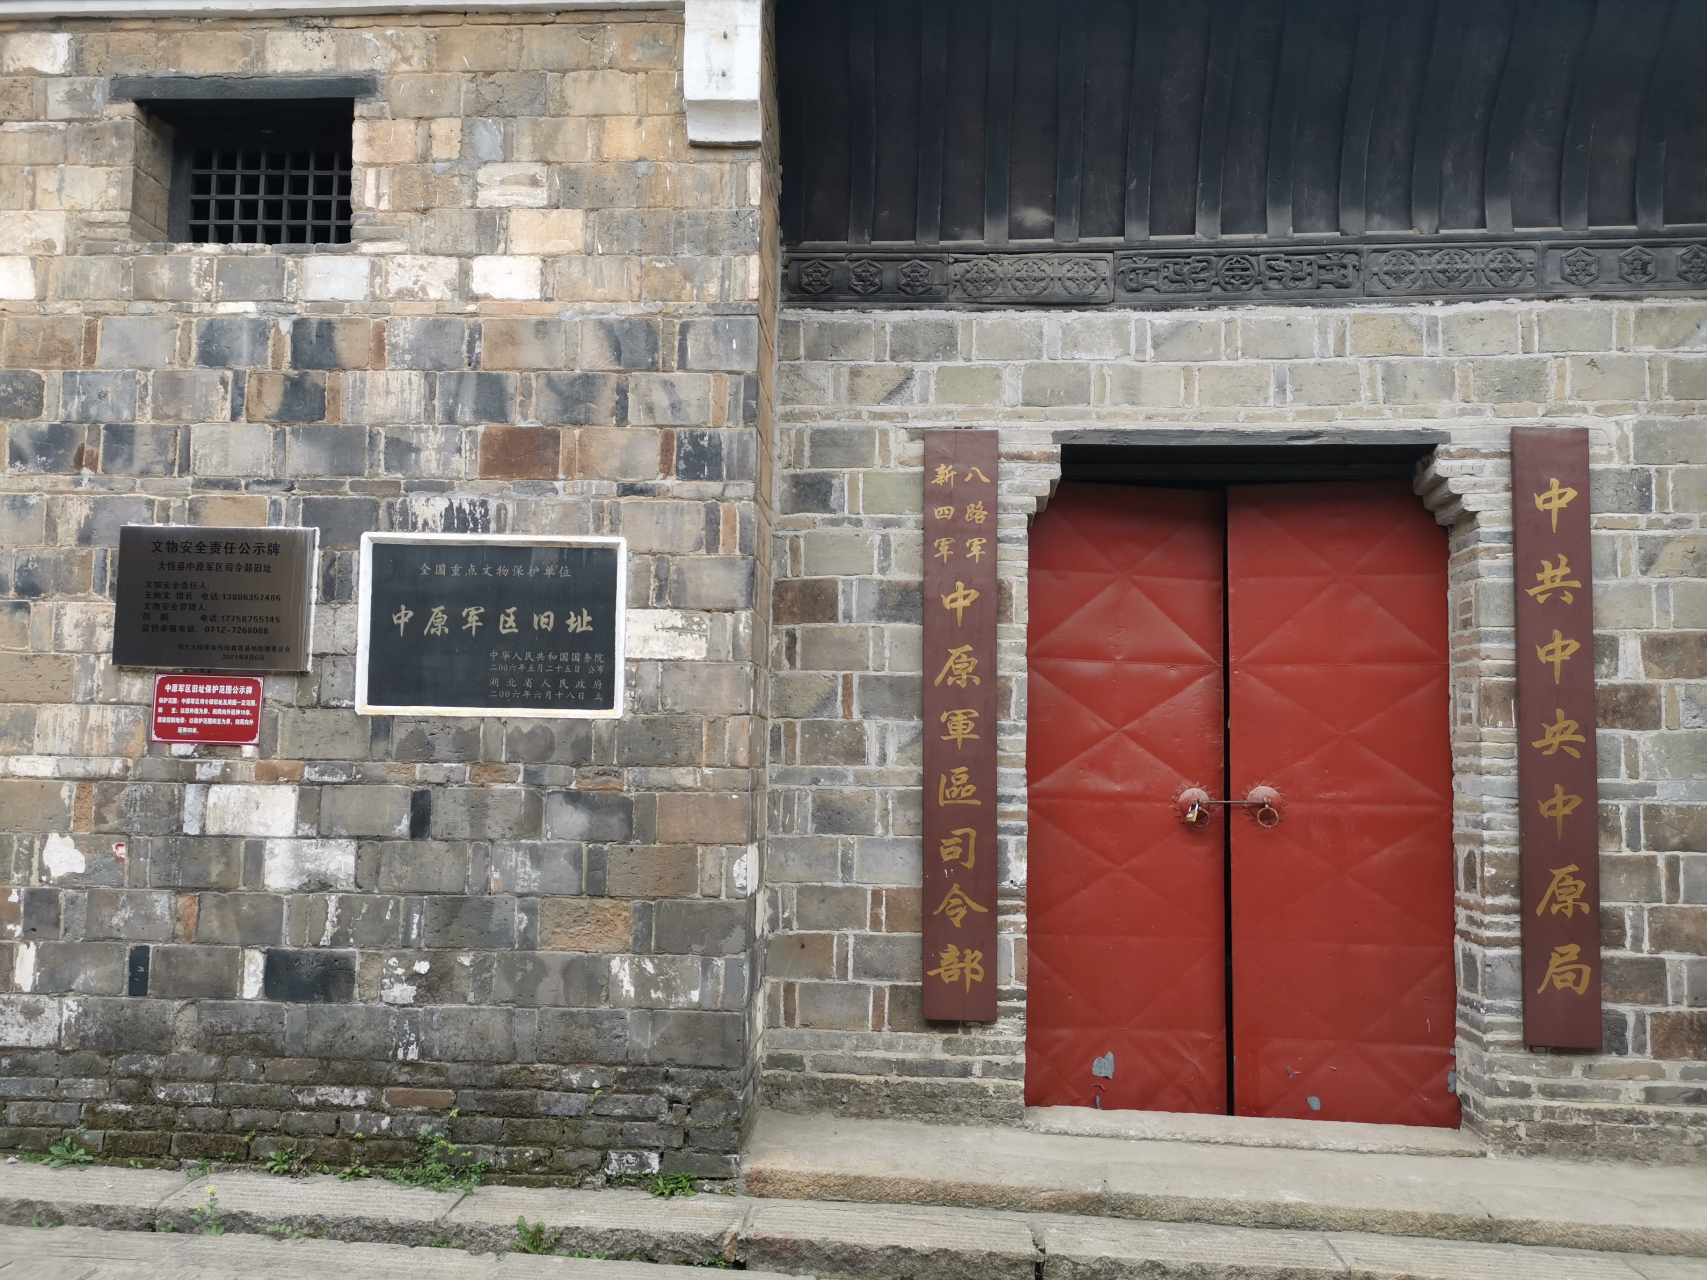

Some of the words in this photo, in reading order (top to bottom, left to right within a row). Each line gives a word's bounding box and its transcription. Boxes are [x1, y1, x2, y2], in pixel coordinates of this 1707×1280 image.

[151, 539, 281, 556] 文物安全责任公示牌
[157, 561, 272, 573] 大悟县中原军区司令部旧址
[419, 562, 572, 578] 全国重点文物保护单位
[391, 604, 594, 638] 中原军区旧址
[204, 626, 269, 635] 0712-7268088
[489, 650, 605, 663] 中华人民共和国国务院
[587, 664, 605, 674] 公布
[164, 683, 253, 694] 中原军区旧址保护范围公示牌
[488, 676, 604, 690] 湖北省人民政府
[1525, 477, 1592, 996] 中共中央中原局
